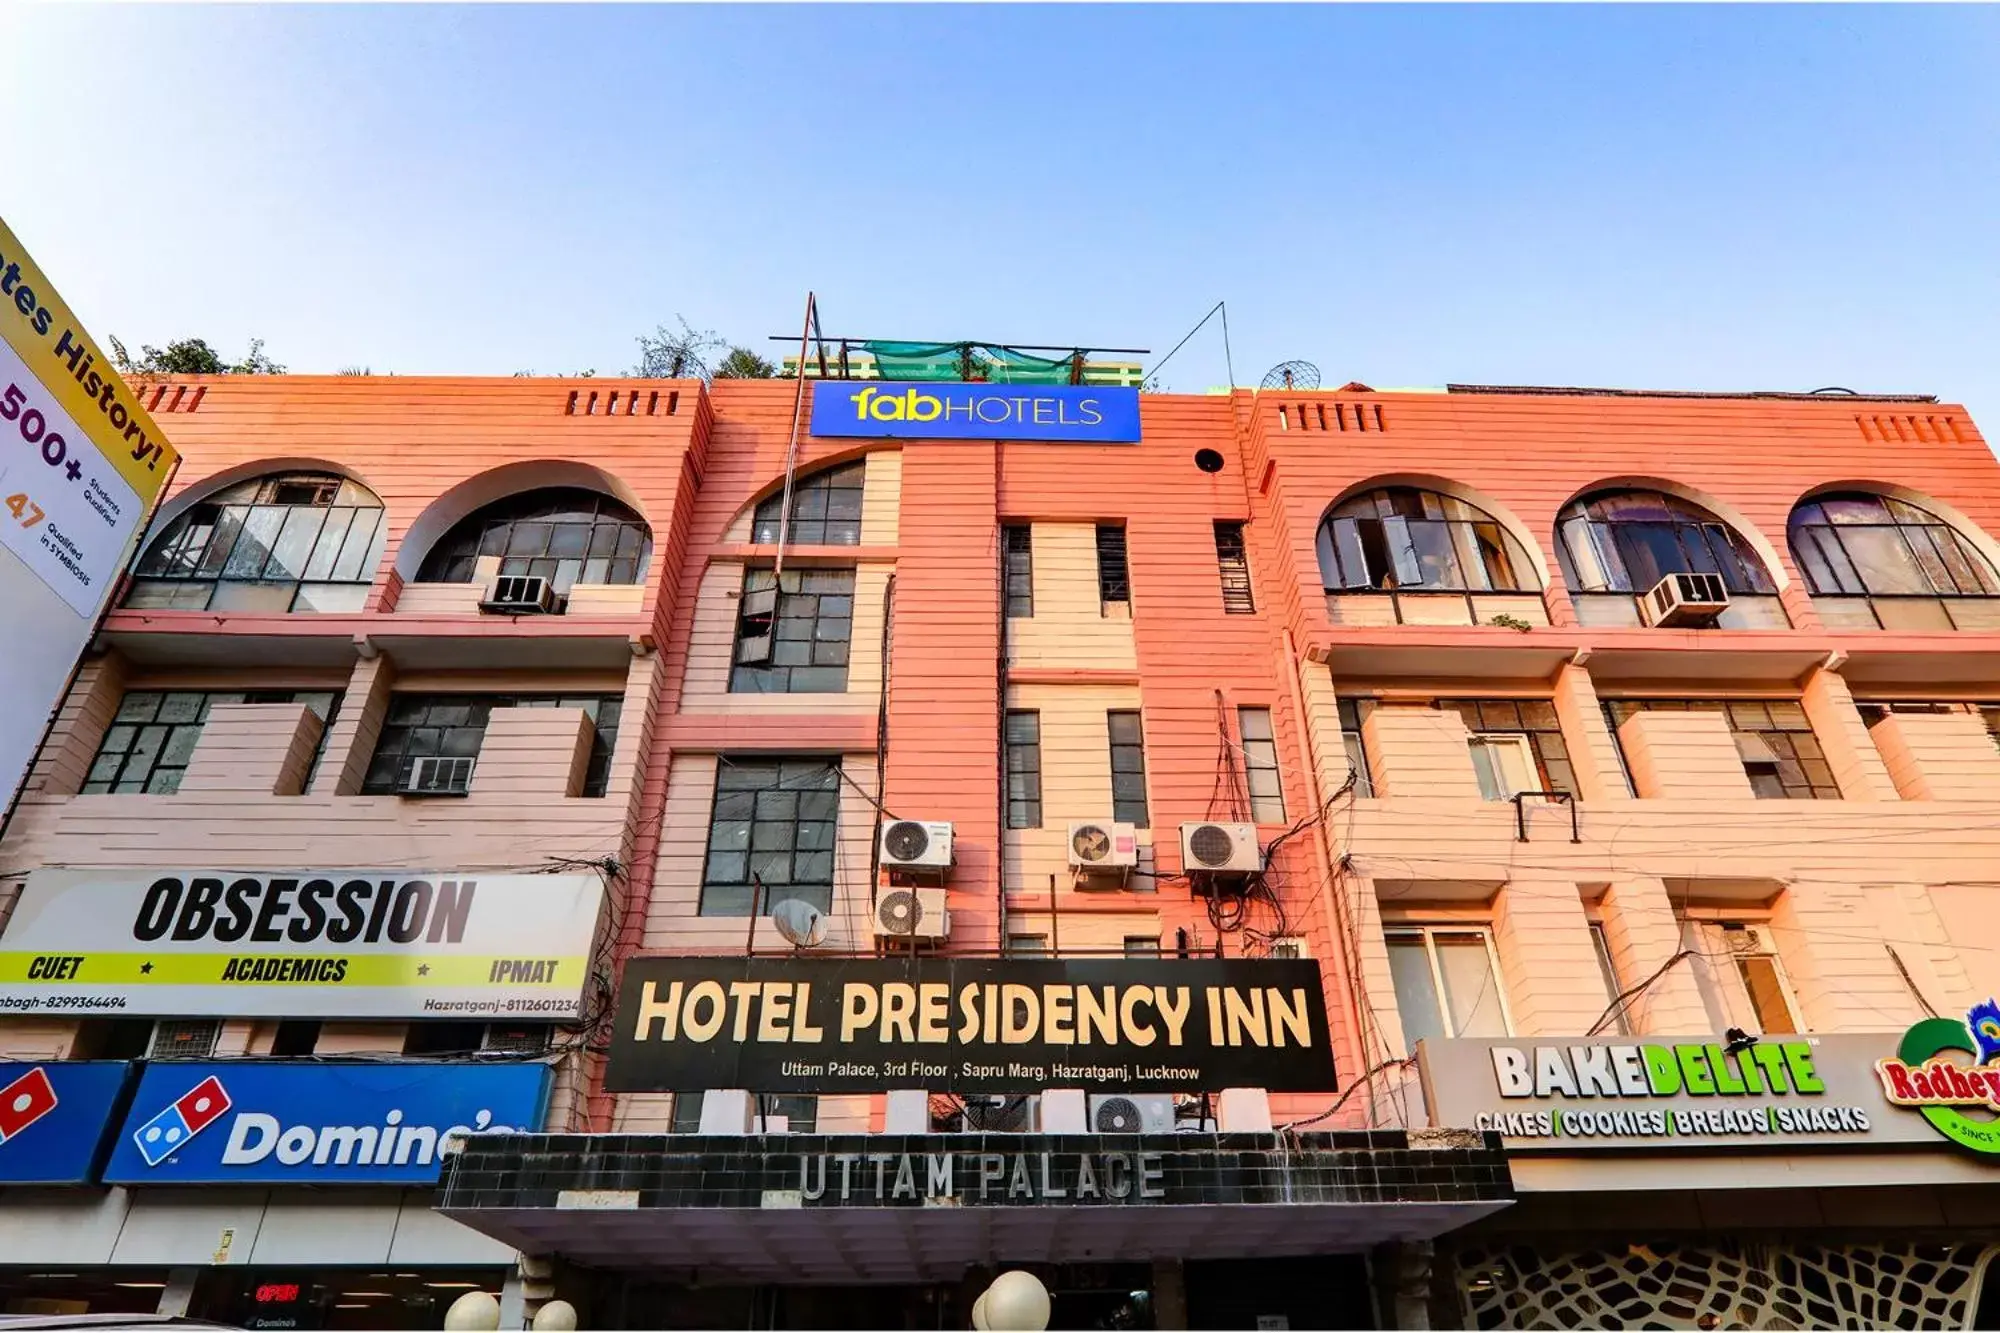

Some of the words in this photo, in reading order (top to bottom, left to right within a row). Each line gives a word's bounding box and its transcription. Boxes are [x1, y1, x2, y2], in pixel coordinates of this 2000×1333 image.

[54, 329, 163, 471] History!
[0, 382, 82, 482] 500+
[5, 493, 46, 529] 47
[83, 489, 117, 528] Qualified
[89, 478, 121, 516] Students
[40, 534, 51, 548] in
[49, 544, 92, 586] SYMBIOSIS
[47, 522, 83, 561] Qualified
[133, 877, 478, 943] OBSESSION
[27, 956, 85, 980] CUET
[221, 958, 349, 982] ACADEMICS
[634, 981, 824, 1043] HOTEL
[839, 983, 1192, 1047] PRESIDENCY
[1206, 986, 1312, 1048] INN
[781, 1061, 824, 1077] Uttam
[828, 1061, 880, 1079] Palace,
[883, 1062, 907, 1077] 3rd
[911, 1062, 948, 1078] Floor
[962, 1062, 1005, 1082] Sapru
[1009, 1064, 1049, 1082] Marg,
[1052, 1063, 1132, 1082] Hazratganj,
[1136, 1065, 1200, 1080] Lucknow
[1961, 1126, 1994, 1143] SINCE
[800, 1152, 954, 1201] UTTAM
[978, 1152, 1167, 1199] PALACE
[256, 1284, 297, 1303] OPEN
